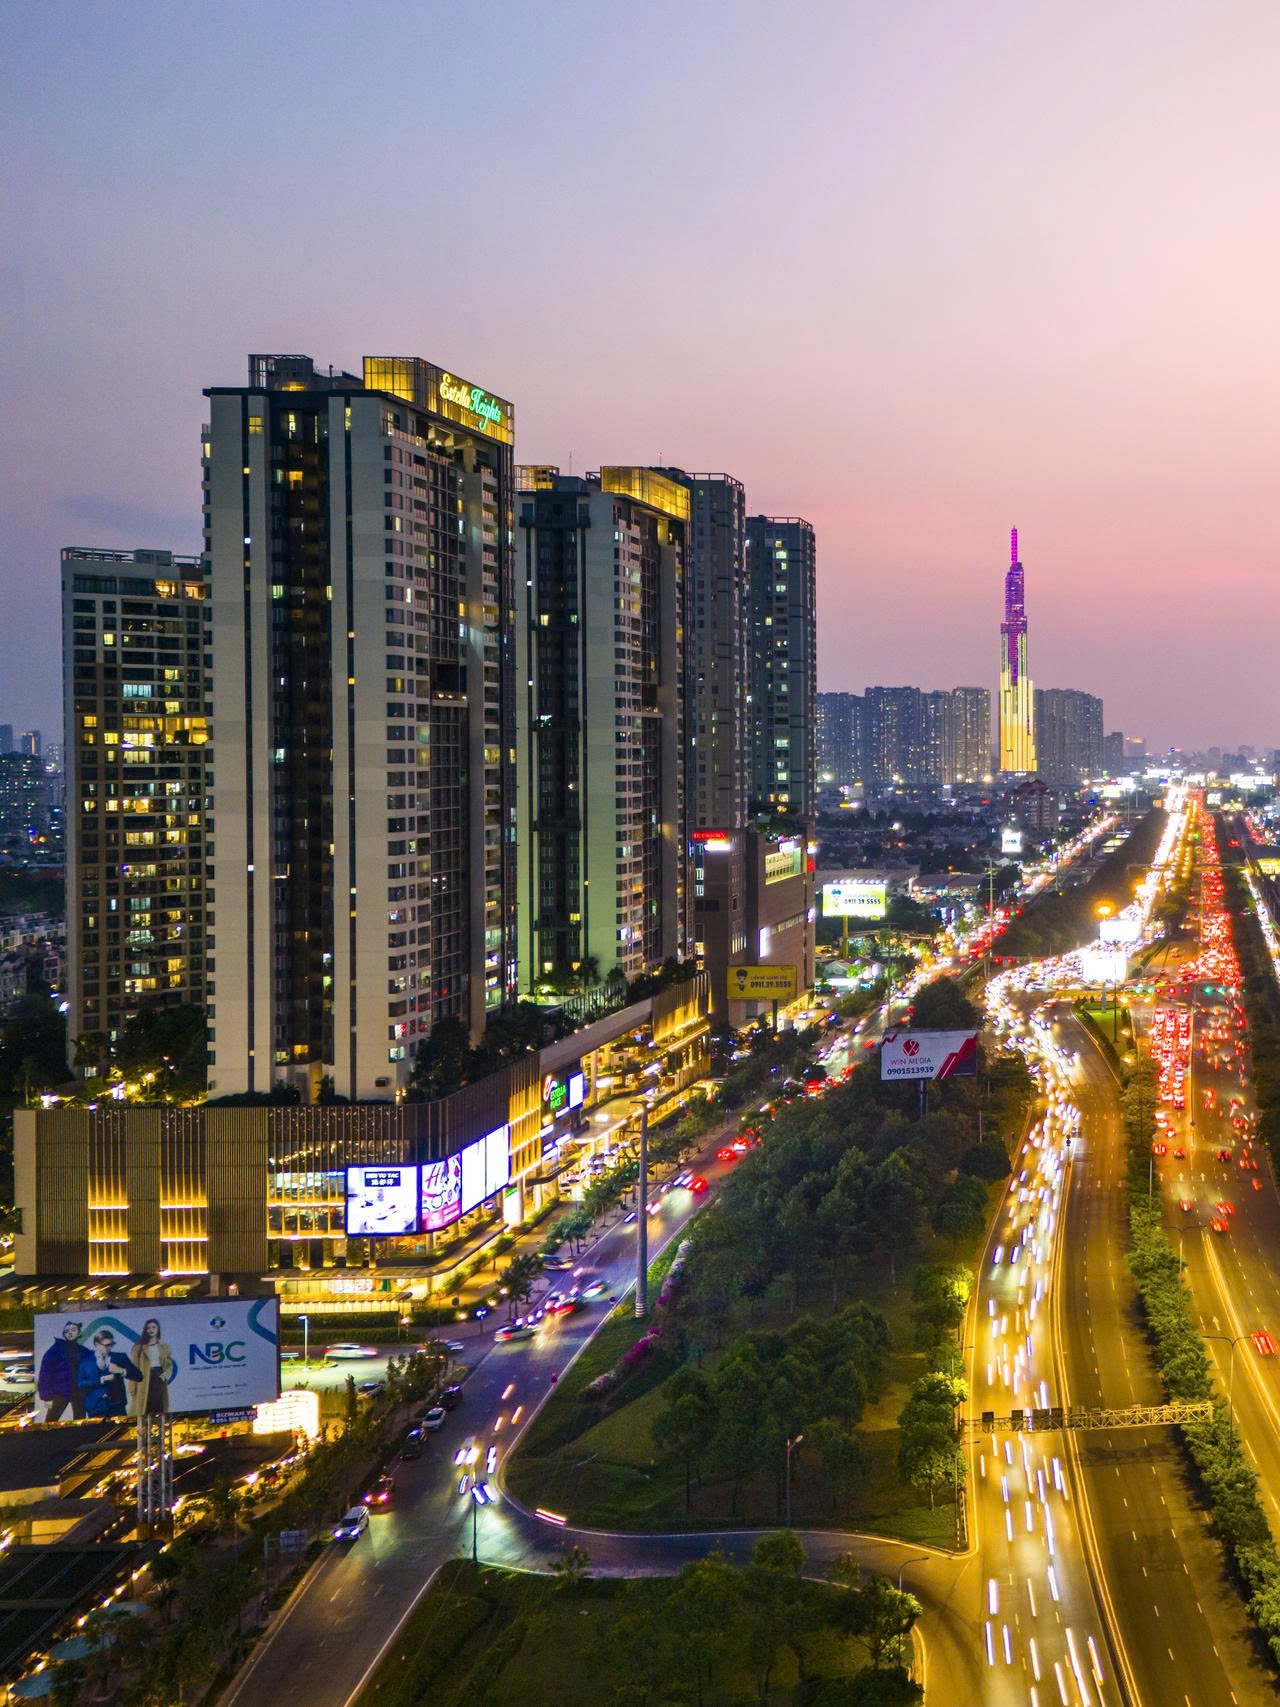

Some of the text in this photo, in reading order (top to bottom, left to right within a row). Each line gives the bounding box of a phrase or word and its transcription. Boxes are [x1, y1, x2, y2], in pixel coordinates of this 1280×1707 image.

[440, 373, 502, 430] Estella Heights
[890, 1057, 932, 1066] WIN MEDIA
[887, 1066, 935, 1075] 0901513939
[189, 1341, 246, 1365] NBC
